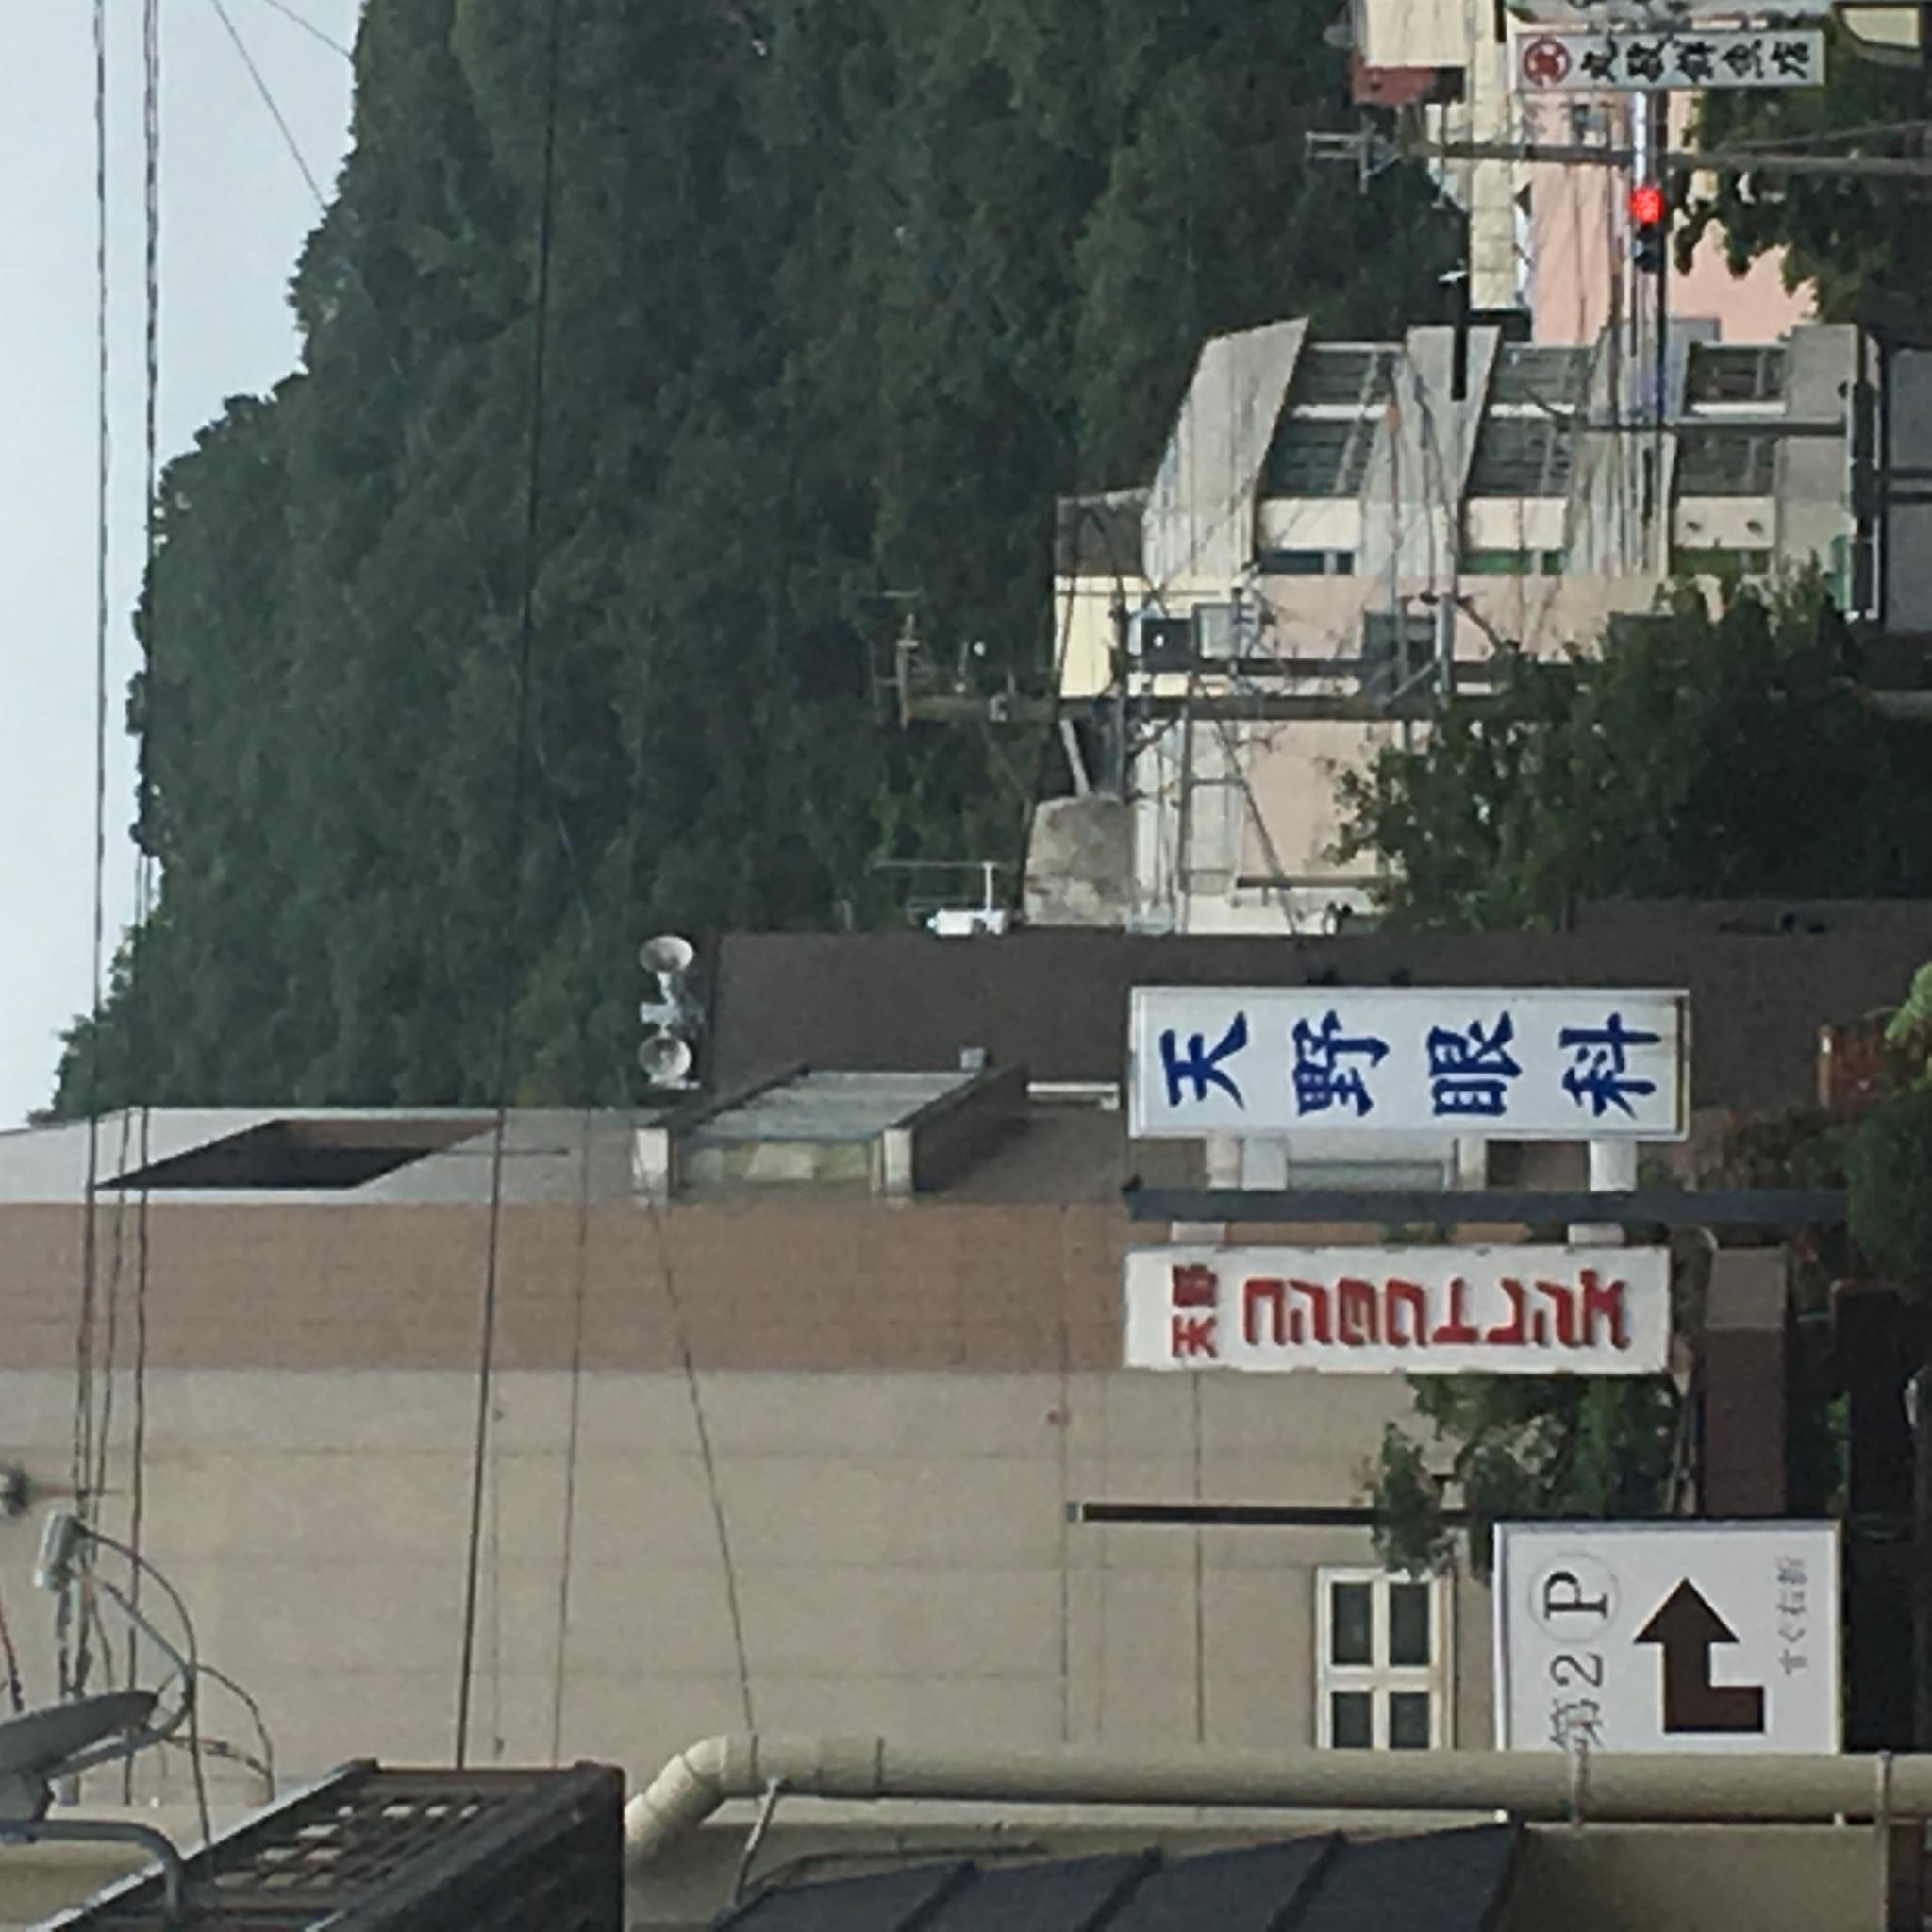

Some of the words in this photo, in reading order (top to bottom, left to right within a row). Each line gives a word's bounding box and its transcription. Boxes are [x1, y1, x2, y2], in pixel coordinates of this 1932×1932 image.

[1159, 1010, 1661, 1119] 天野眼科
[1171, 1264, 1218, 1358] 天野
[1244, 1270, 1630, 1349] コンタクトレンズ
